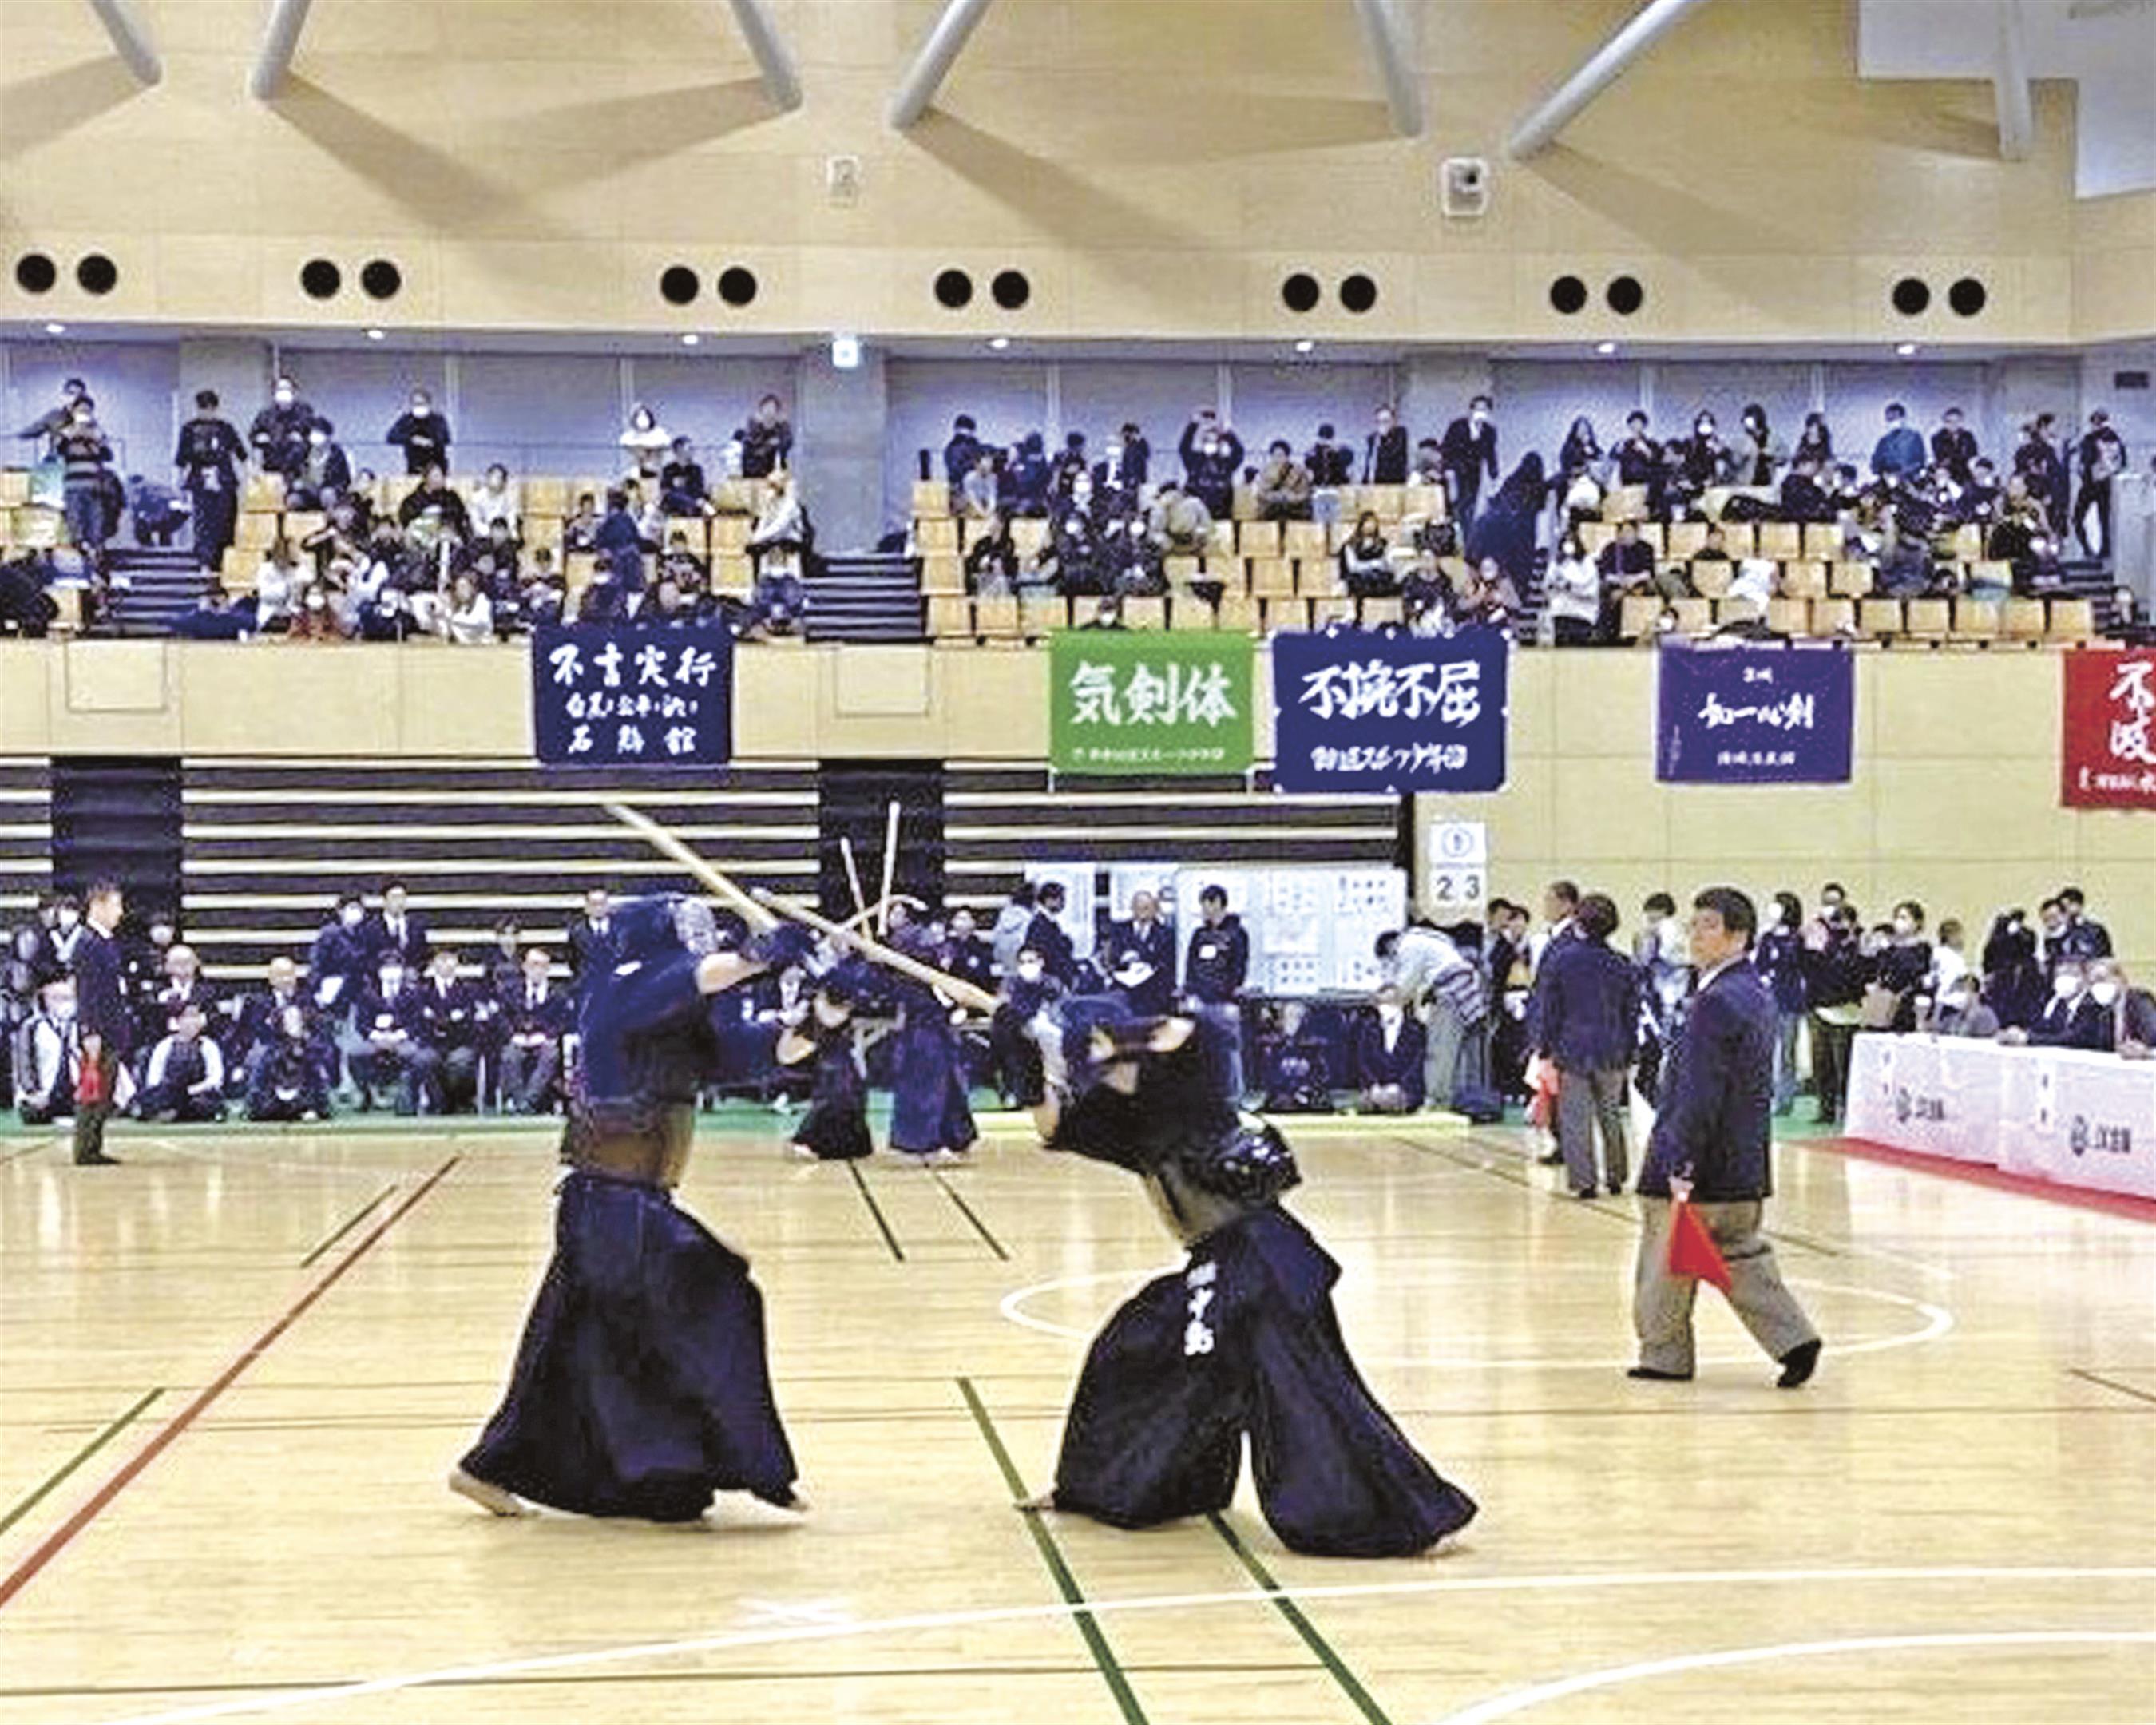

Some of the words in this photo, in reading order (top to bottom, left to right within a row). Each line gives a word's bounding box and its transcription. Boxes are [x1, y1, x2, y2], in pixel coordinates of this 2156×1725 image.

[549, 642, 717, 688] 不言実行
[1068, 660, 1237, 728] 気剣体
[1298, 658, 1481, 728] 不撓不屈
